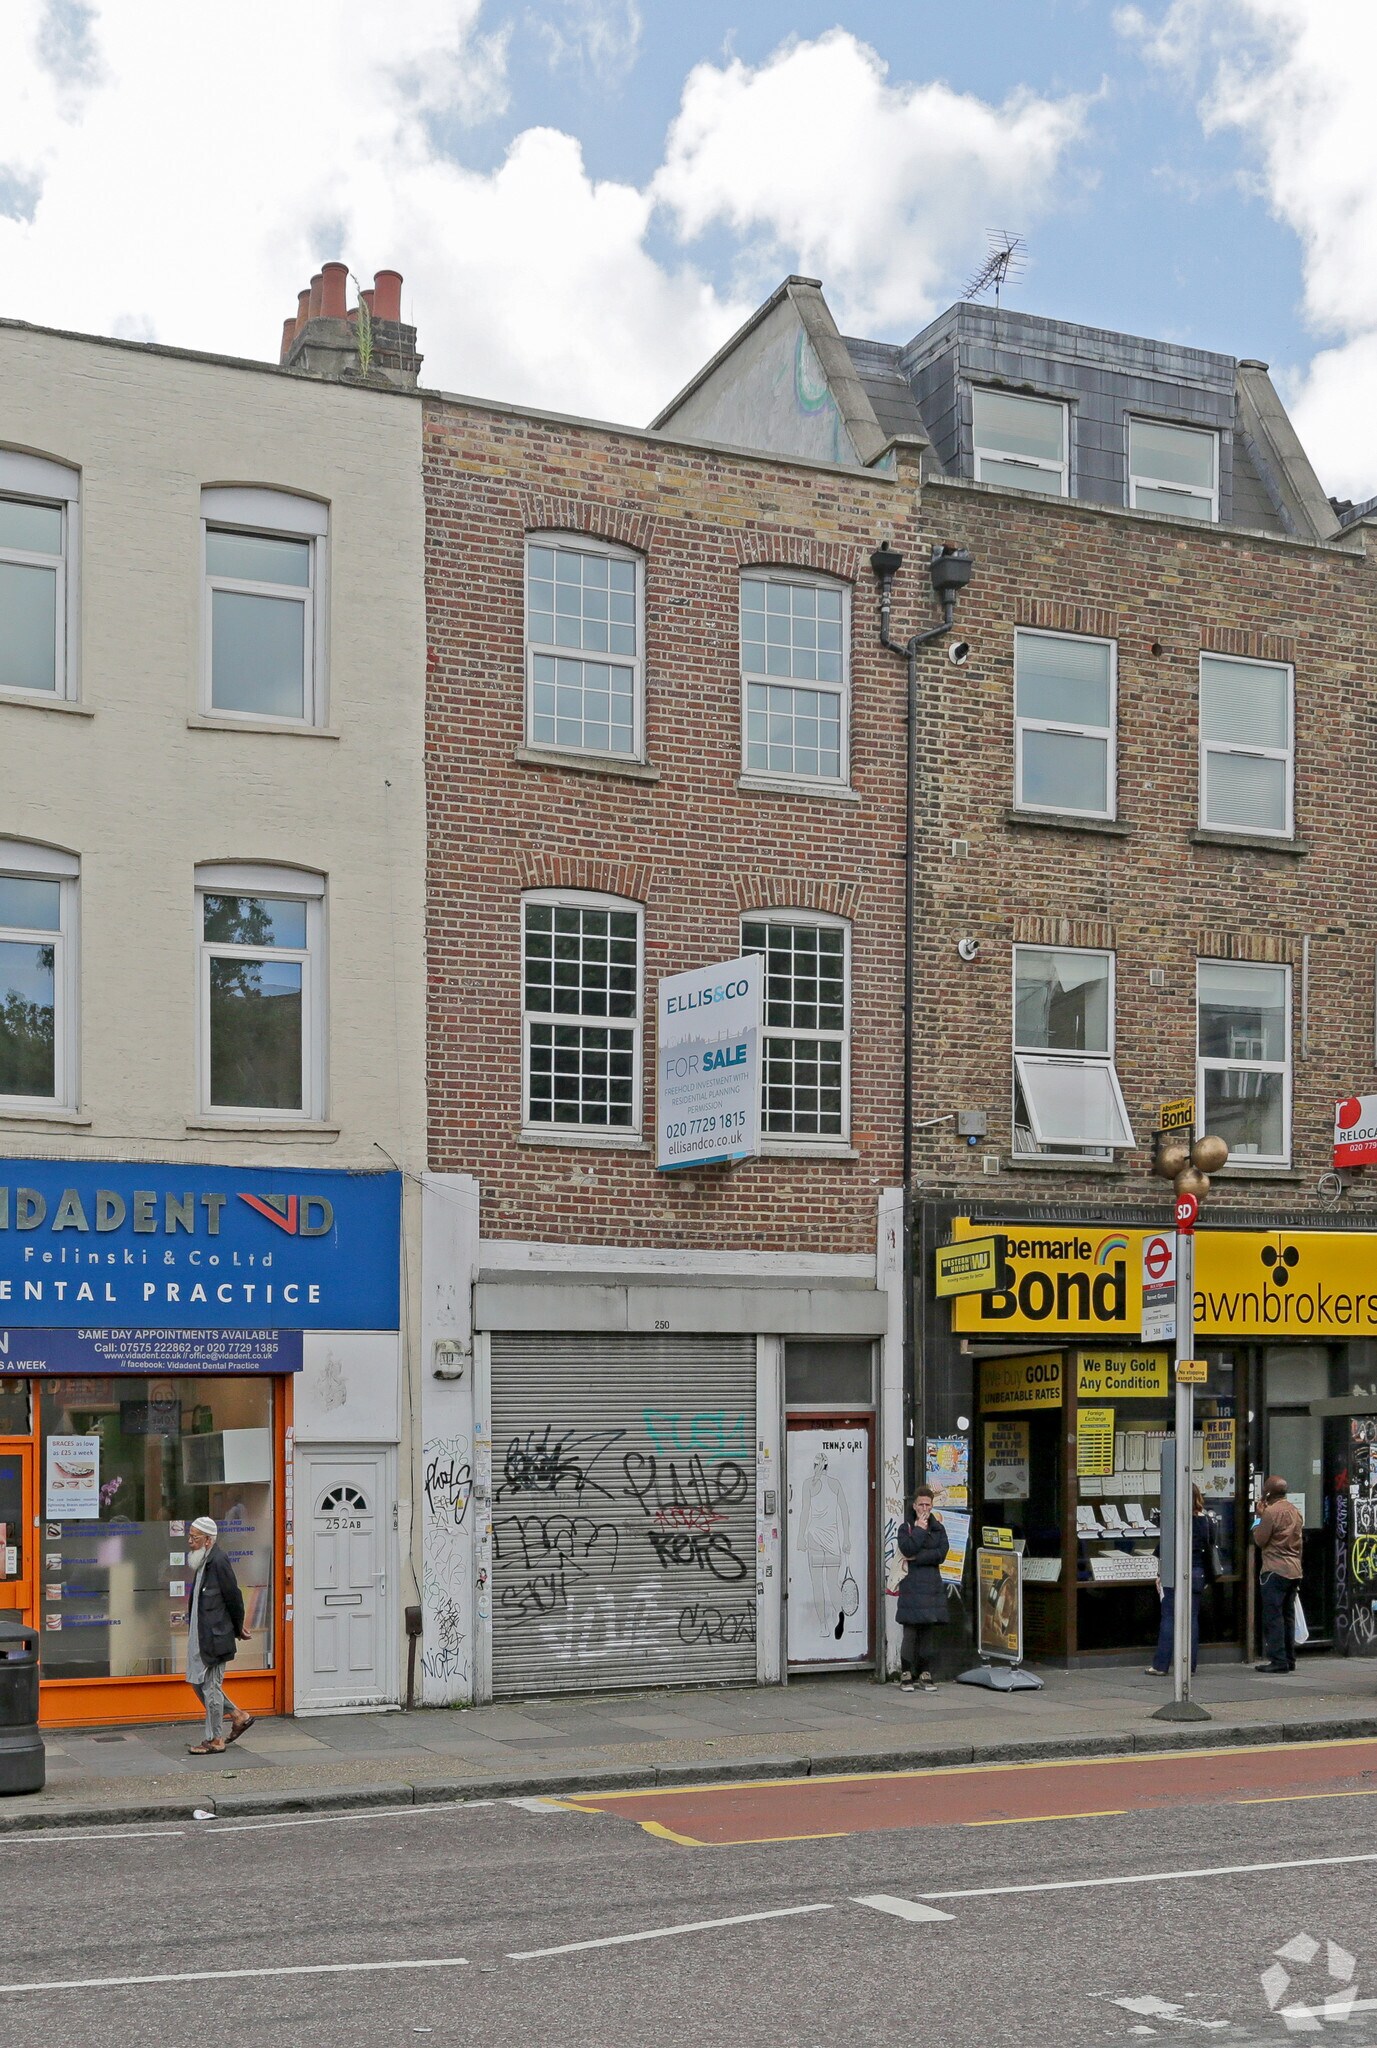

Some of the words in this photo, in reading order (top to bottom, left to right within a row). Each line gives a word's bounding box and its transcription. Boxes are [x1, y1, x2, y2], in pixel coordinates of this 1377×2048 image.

[667, 979, 749, 1014] ELLIS&CO
[666, 1055, 699, 1080] FOR
[702, 1044, 747, 1072] SALE
[664, 1081, 695, 1096] FREEHOLD
[695, 1075, 732, 1090] INVESTMENT
[733, 1072, 749, 1082] WITH
[671, 1093, 707, 1106] RESIDENTIAL
[709, 1085, 740, 1100] PLANNING
[688, 1102, 722, 1114] PERMISSION
[666, 1121, 686, 1138] 020
[690, 1117, 716, 1135] 7729
[720, 1111, 746, 1129] 1815
[1162, 1106, 1192, 1128] Bond
[668, 1130, 742, 1155] ellisandco.co.uk
[1178, 1204, 1192, 1220] SD
[1006, 1237, 1092, 1260] bemarle
[24, 1247, 148, 1266] Felinski
[164, 1251, 175, 1265] &
[188, 1250, 220, 1266] Co
[234, 1252, 272, 1266] Ltd
[942, 1257, 969, 1268] WESTERN
[951, 1264, 970, 1273] UNION
[144, 1283, 320, 1303] PRACTICE
[981, 1261, 1126, 1321] Bond
[1194, 1282, 1377, 1323] awnbrokers
[655, 1320, 670, 1329] 250
[78, 1330, 108, 1340] SAME
[110, 1330, 132, 1340] DAY
[134, 1330, 219, 1340] APPOINTMENTS
[221, 1331, 278, 1340] AVAILABLE
[94, 1342, 118, 1352] Call:
[120, 1342, 152, 1352] 07575
[154, 1342, 192, 1352] 222862
[207, 1343, 225, 1352] 020
[228, 1343, 254, 1352] 7729
[256, 1343, 278, 1352] 1385
[6, 1361, 14, 1370] A
[17, 1361, 46, 1370] WEEK
[128, 1361, 166, 1369] facebook:
[167, 1362, 200, 1370] Vidadent
[202, 1362, 226, 1370] Dental
[228, 1362, 260, 1370] Practice
[1084, 1359, 1100, 1372] We
[1105, 1359, 1126, 1374] Buy
[1130, 1359, 1156, 1372] Gold
[1026, 1364, 1059, 1383] GOLD
[1080, 1377, 1102, 1391] Any
[1105, 1376, 1160, 1389] Condition
[984, 1390, 1033, 1404] UNBEATABLE
[1035, 1387, 1060, 1400] RATES
[1208, 1422, 1218, 1432] WE
[1219, 1421, 1231, 1432] BUY
[1206, 1432, 1232, 1440] JEWELLERY
[822, 1441, 844, 1452] TENNIS
[848, 1441, 862, 1452] GIRL
[1207, 1442, 1232, 1450] DIAMONDS
[988, 1458, 1024, 1466] JEWELLERY
[1208, 1451, 1230, 1459] WATCHES
[1212, 1460, 1226, 1468] COINS
[326, 1518, 361, 1529] 252AB
